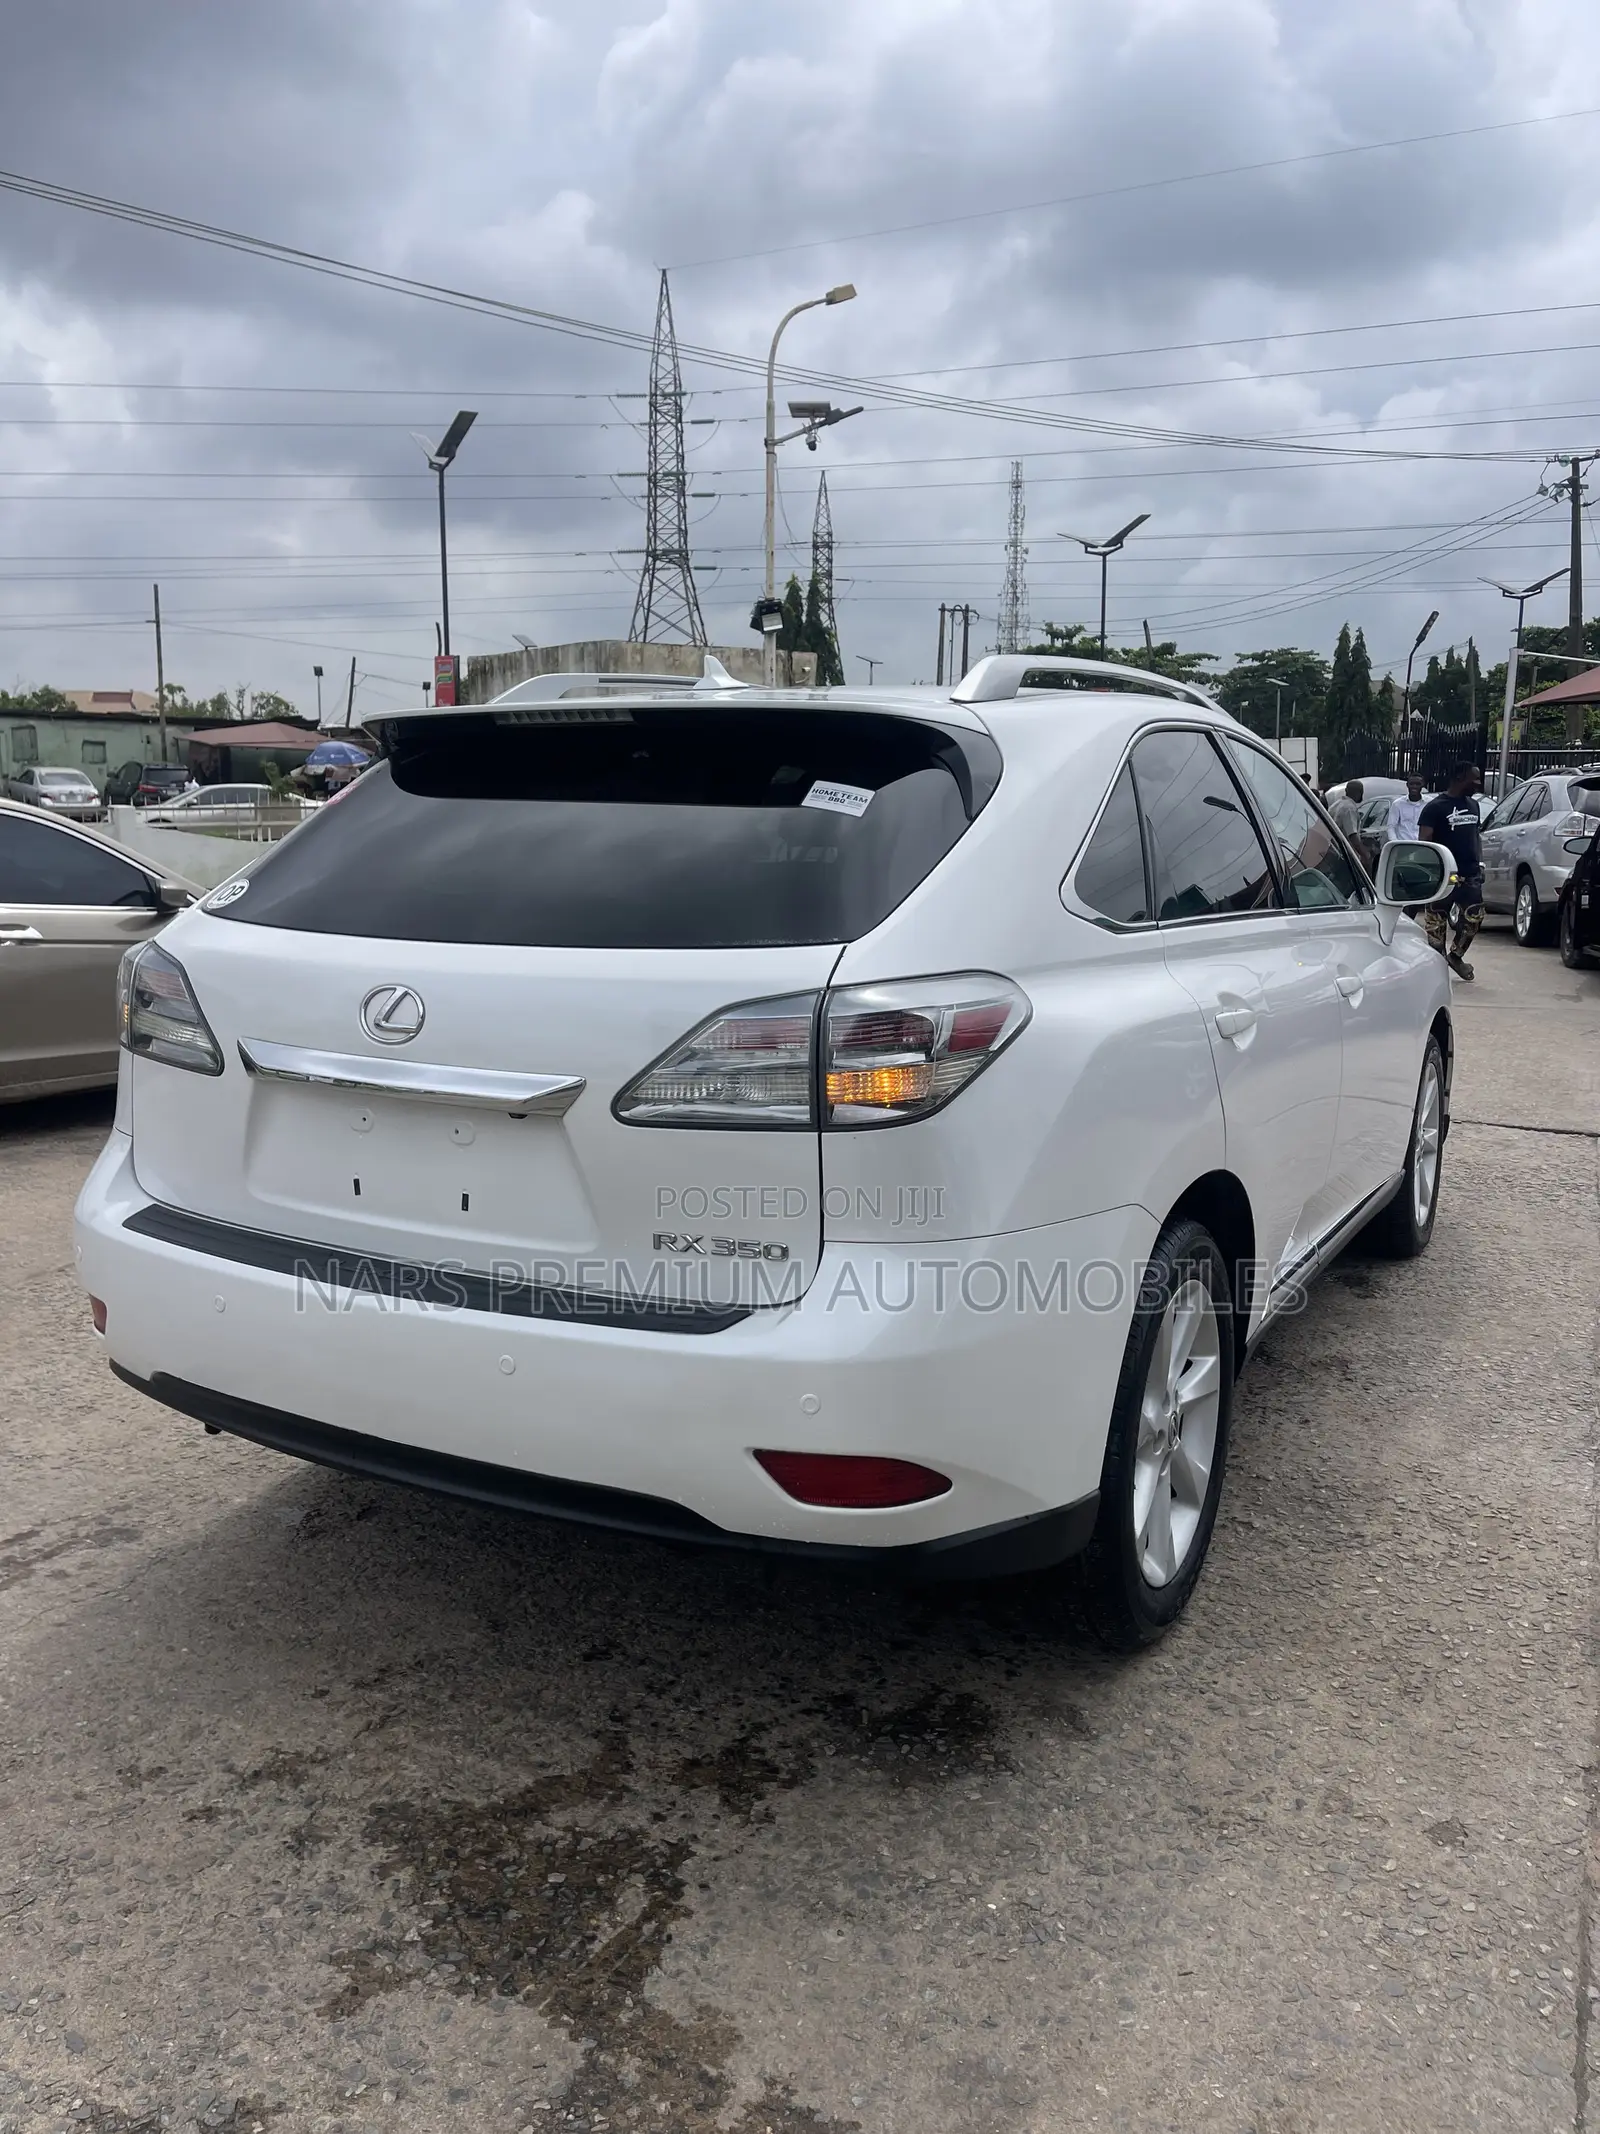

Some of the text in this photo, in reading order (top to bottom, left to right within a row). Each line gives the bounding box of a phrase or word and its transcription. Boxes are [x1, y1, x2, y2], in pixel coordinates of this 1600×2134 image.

[811, 788, 868, 804] HOME TEAM
[652, 1231, 790, 1262] RX 350
